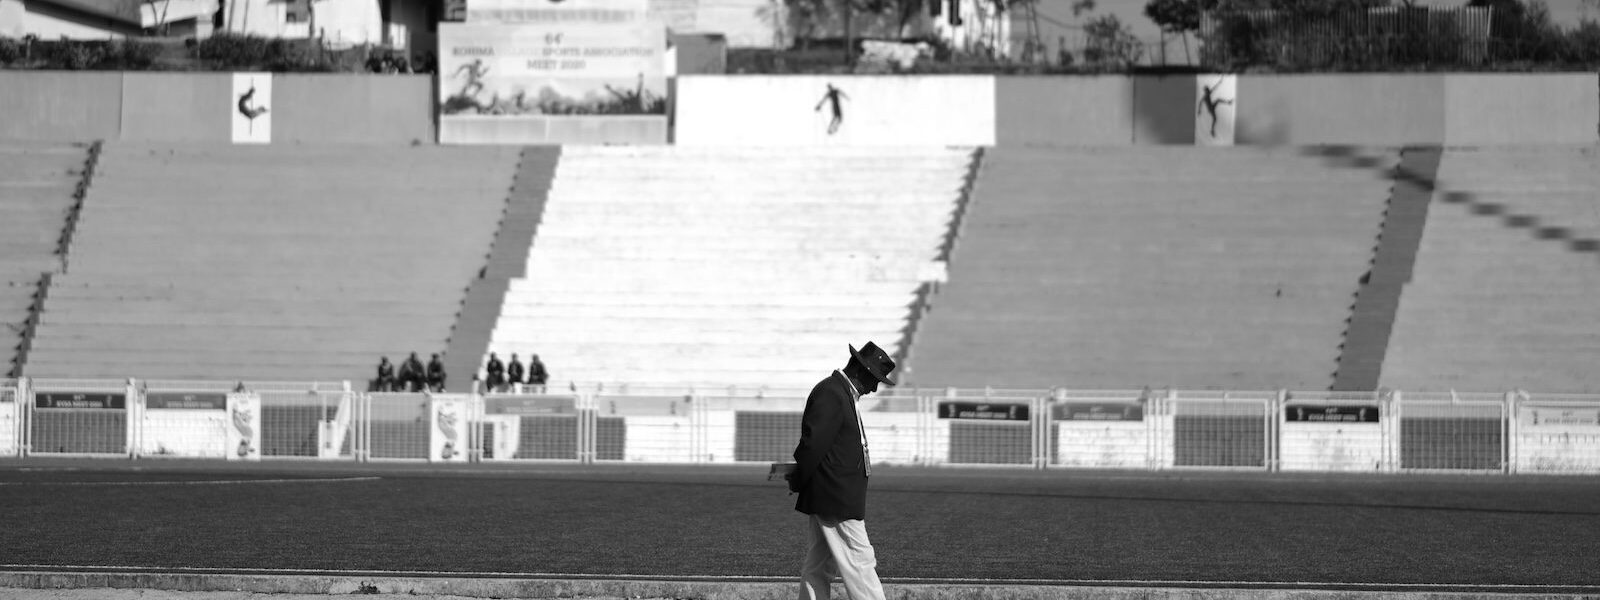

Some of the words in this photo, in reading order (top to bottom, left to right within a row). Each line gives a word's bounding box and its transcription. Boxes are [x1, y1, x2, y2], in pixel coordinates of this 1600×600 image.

[542, 47, 580, 57] SPORTS
[583, 47, 655, 57] ASSOCIATION
[527, 59, 557, 70] MEET
